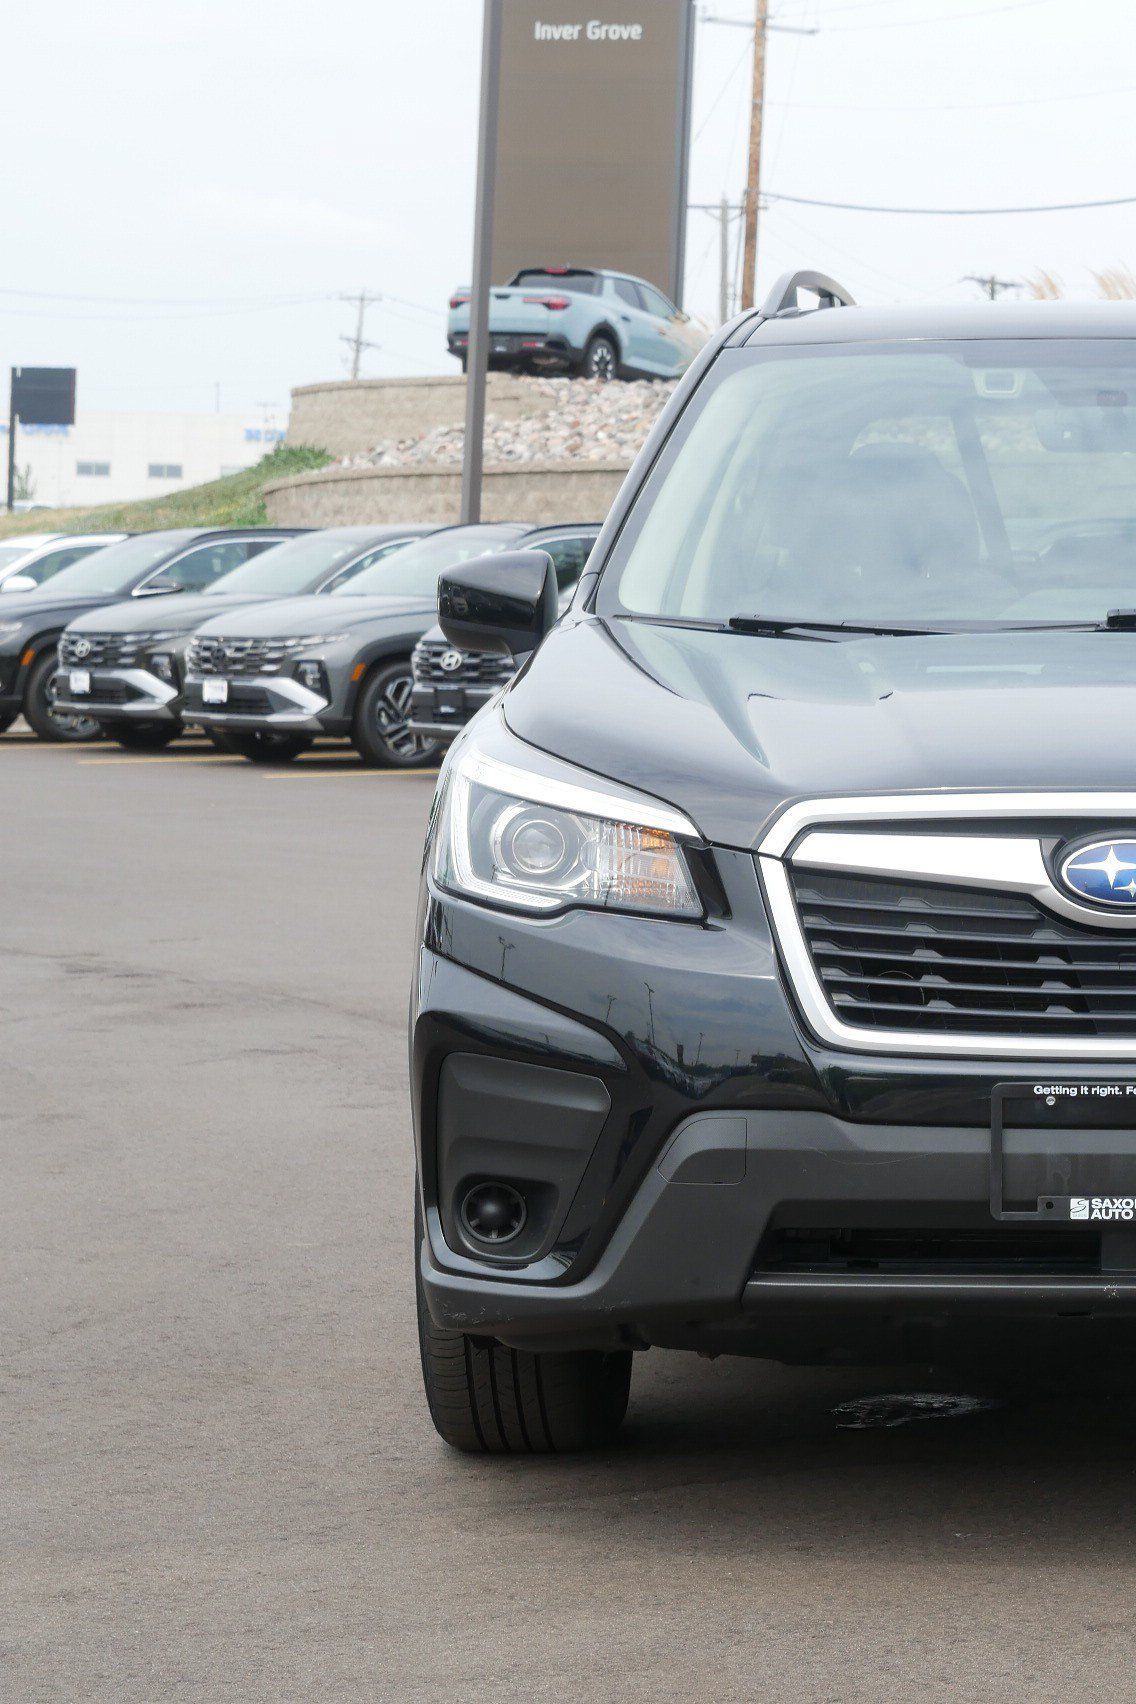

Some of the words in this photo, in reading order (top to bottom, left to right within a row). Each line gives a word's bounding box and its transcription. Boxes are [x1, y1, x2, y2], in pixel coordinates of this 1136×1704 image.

[534, 21, 582, 40] Inver
[586, 20, 643, 40] Grove
[1033, 1085, 1078, 1098] Getting
[1080, 1085, 1089, 1095] it
[1091, 1085, 1123, 1097] right.
[1091, 1208, 1134, 1220] AUTO
